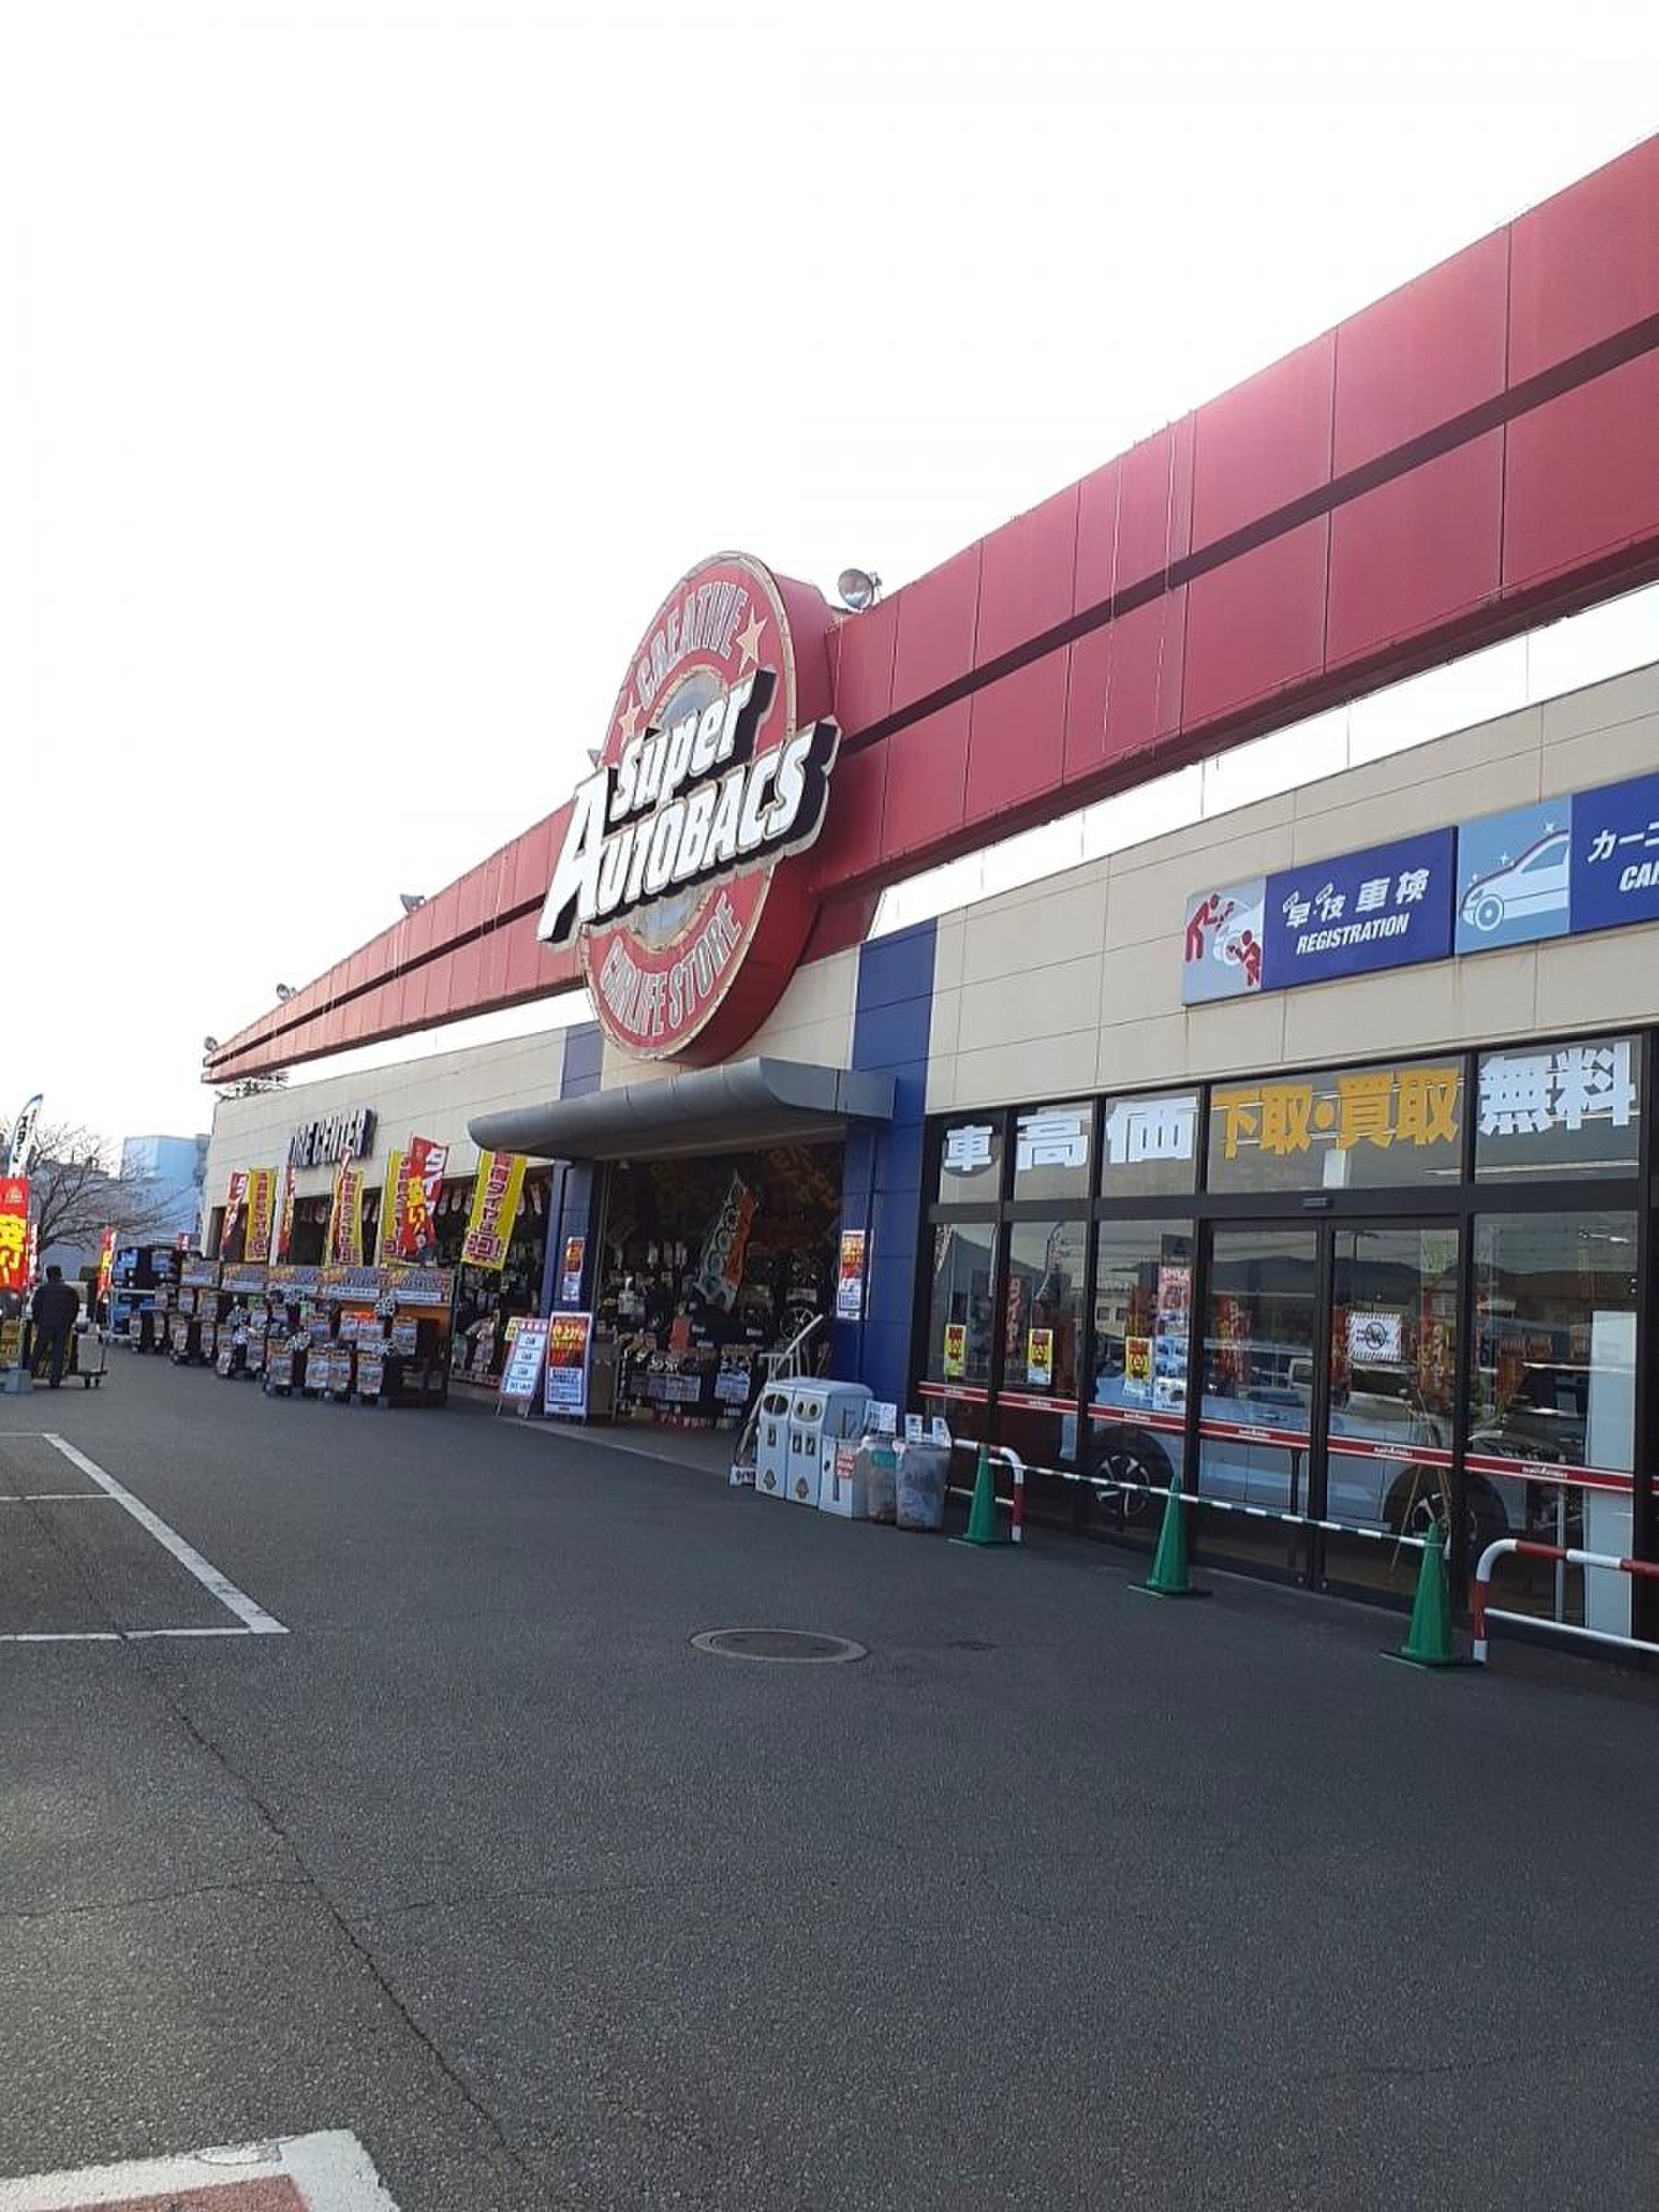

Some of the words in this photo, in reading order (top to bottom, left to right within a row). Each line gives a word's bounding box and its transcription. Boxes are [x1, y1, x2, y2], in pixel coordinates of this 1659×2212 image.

[635, 580, 749, 712] CREATIVE
[668, 889, 742, 1029] STORE
[1297, 912, 1410, 955] REGISTRATION
[943, 1124, 993, 1171] 車
[1477, 1041, 1637, 1136] 無料
